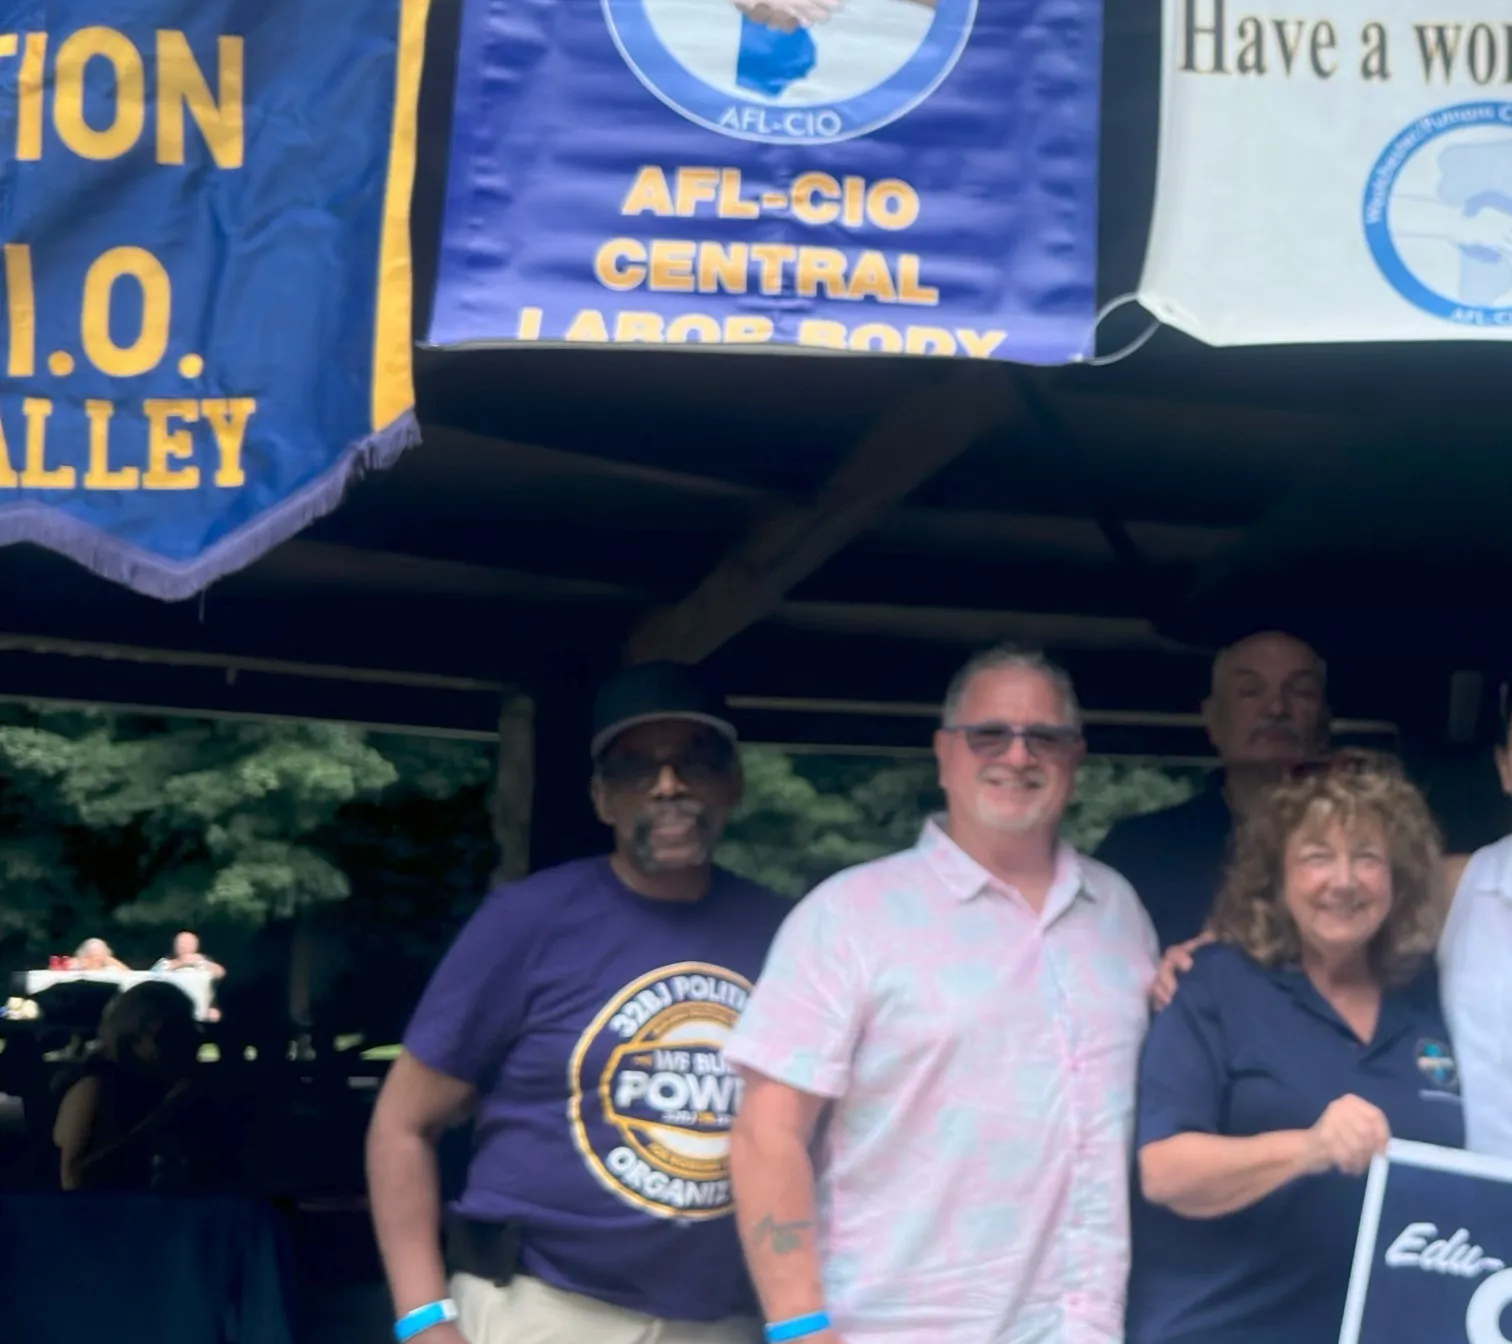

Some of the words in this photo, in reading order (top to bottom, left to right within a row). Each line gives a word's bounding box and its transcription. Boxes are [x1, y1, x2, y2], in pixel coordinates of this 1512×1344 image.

[1360, 20, 1393, 80] a
[719, 106, 842, 138] AFL-CIO
[621, 165, 920, 231] AFL-CIO
[594, 237, 939, 305] CENTRAL
